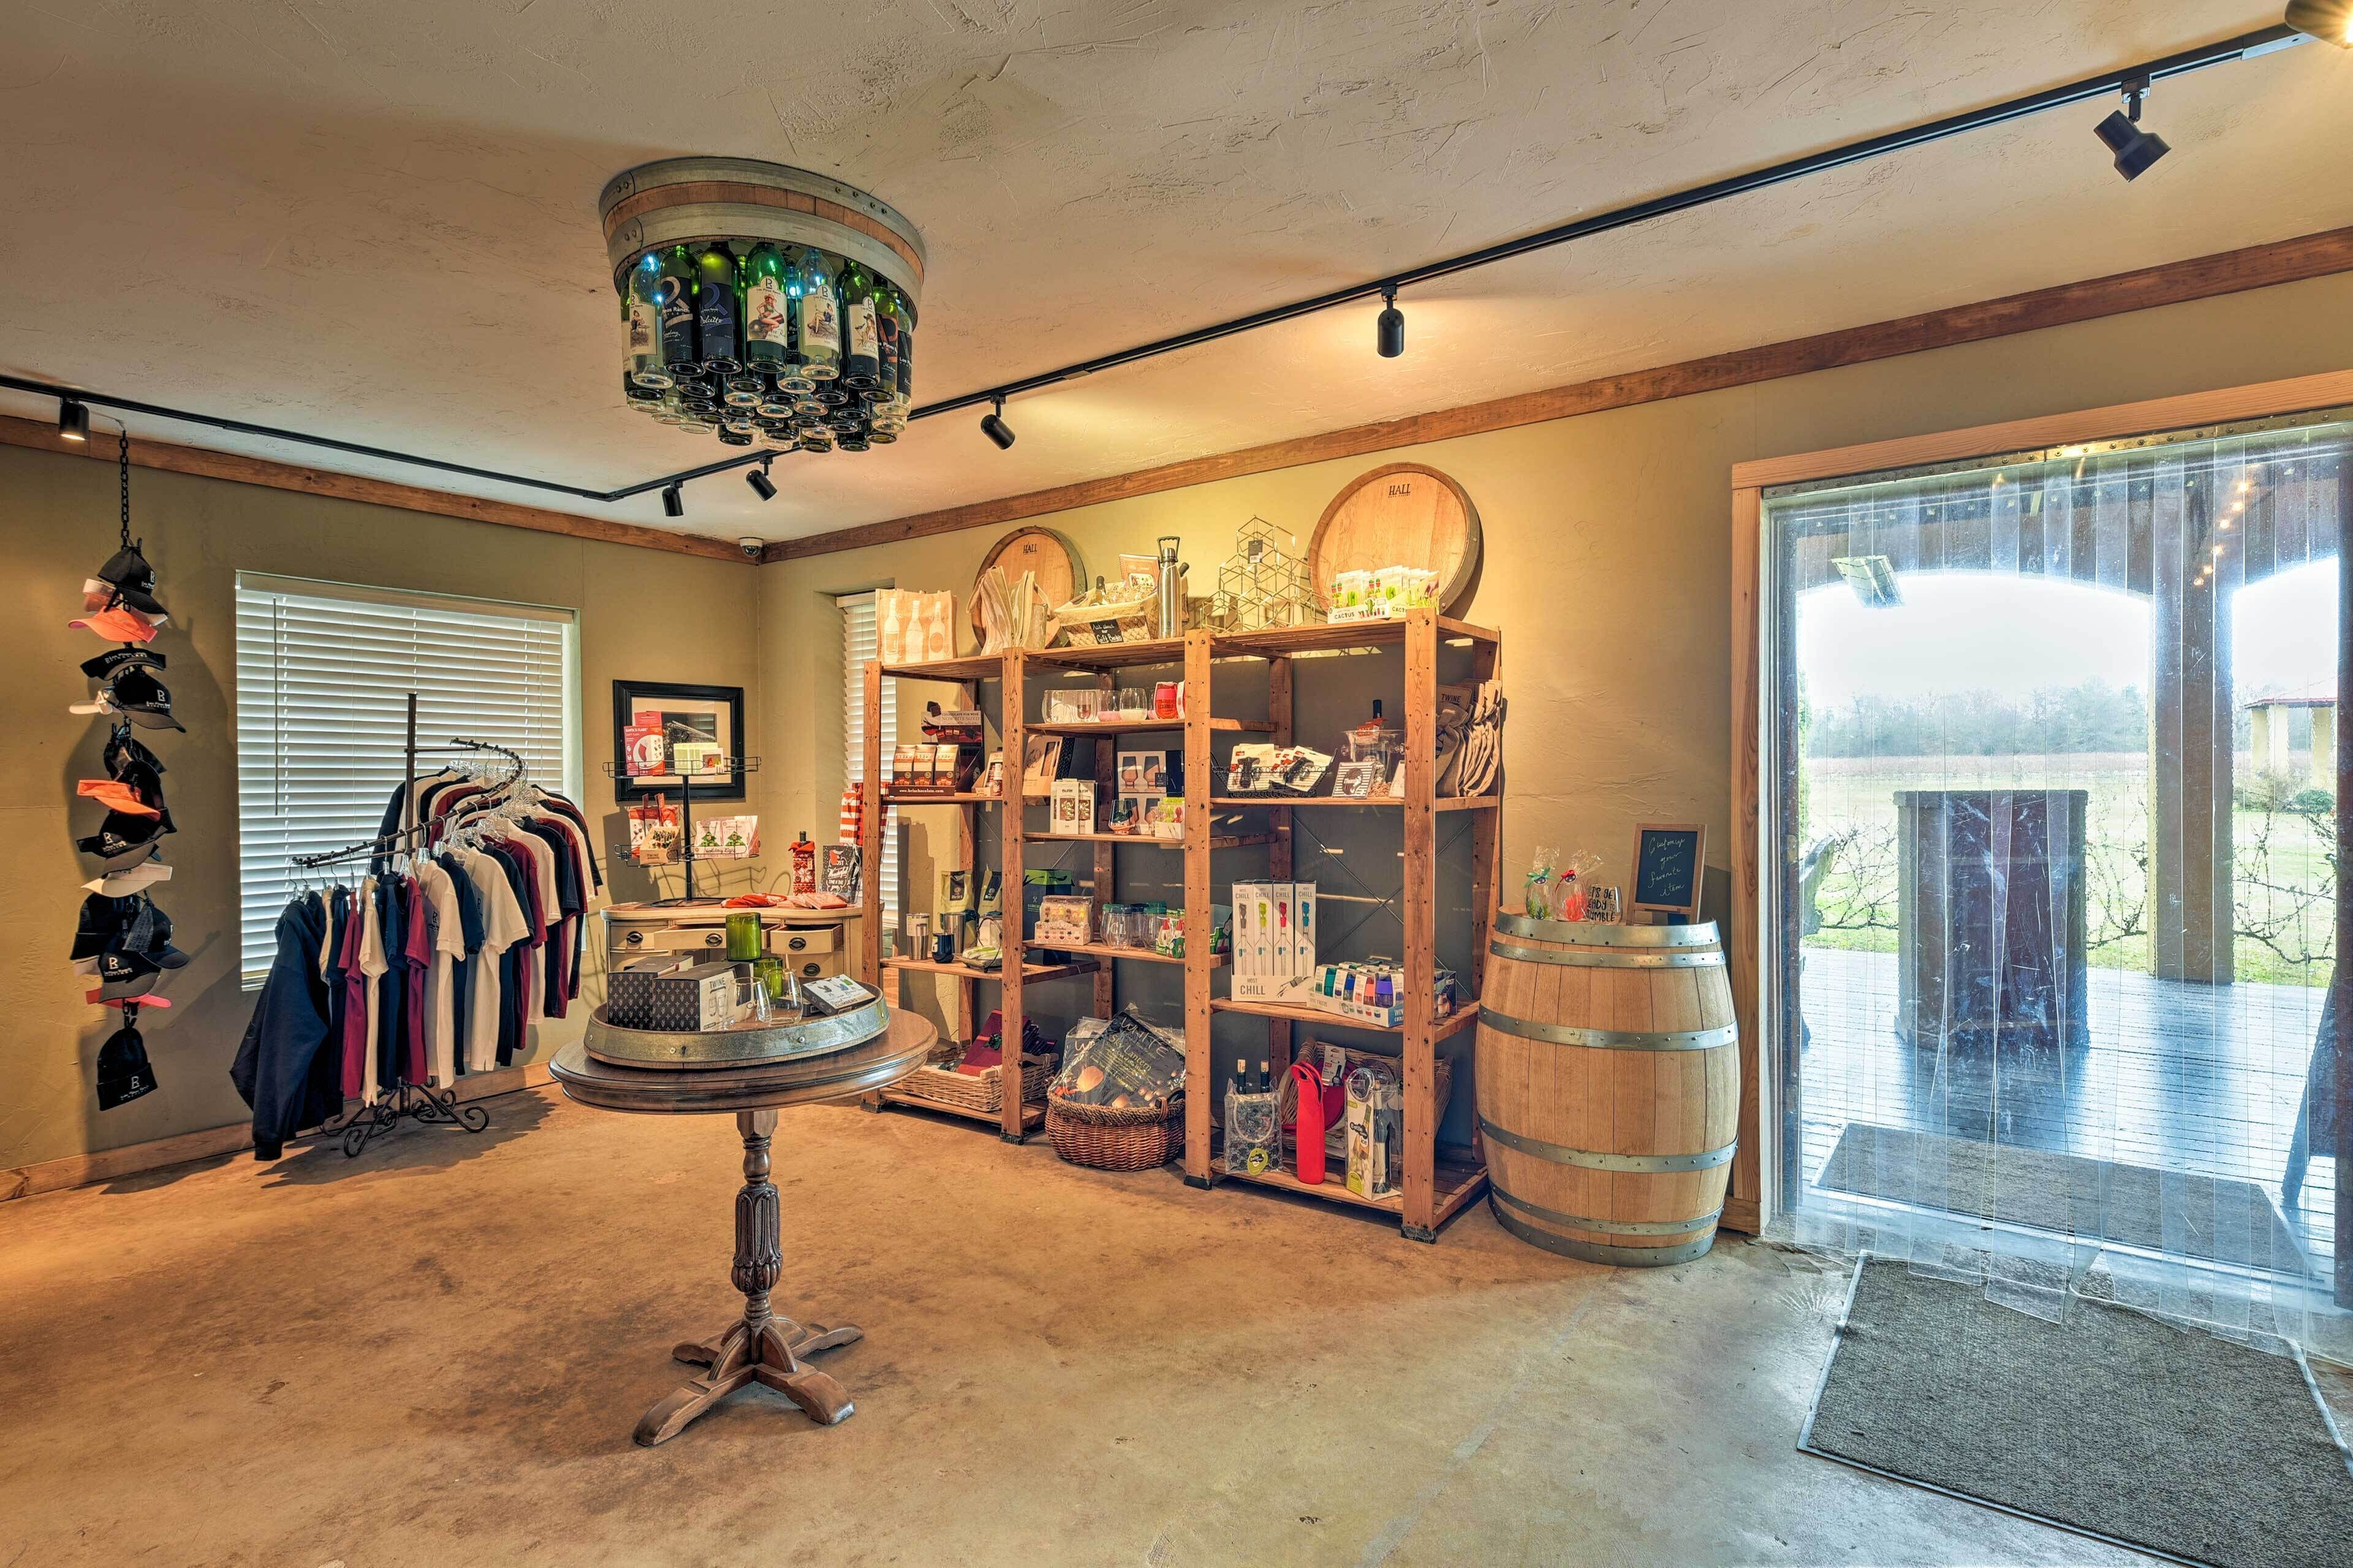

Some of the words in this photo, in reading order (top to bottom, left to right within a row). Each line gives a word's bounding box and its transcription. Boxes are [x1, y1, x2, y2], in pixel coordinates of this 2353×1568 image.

[1389, 483, 1411, 496] HALL
[1023, 542, 1037, 553] HALL
[1441, 693, 1461, 703] TWINE
[1659, 851, 1683, 870] your
[1660, 883, 1685, 896] item
[1588, 899, 1607, 911] EADY
[709, 977, 726, 989] TWINE
[1240, 985, 1266, 996] CHILL
[1121, 1017, 1169, 1059] WHITE
[1109, 1034, 1124, 1049] Sky
[1124, 1045, 1152, 1071] Lantern
